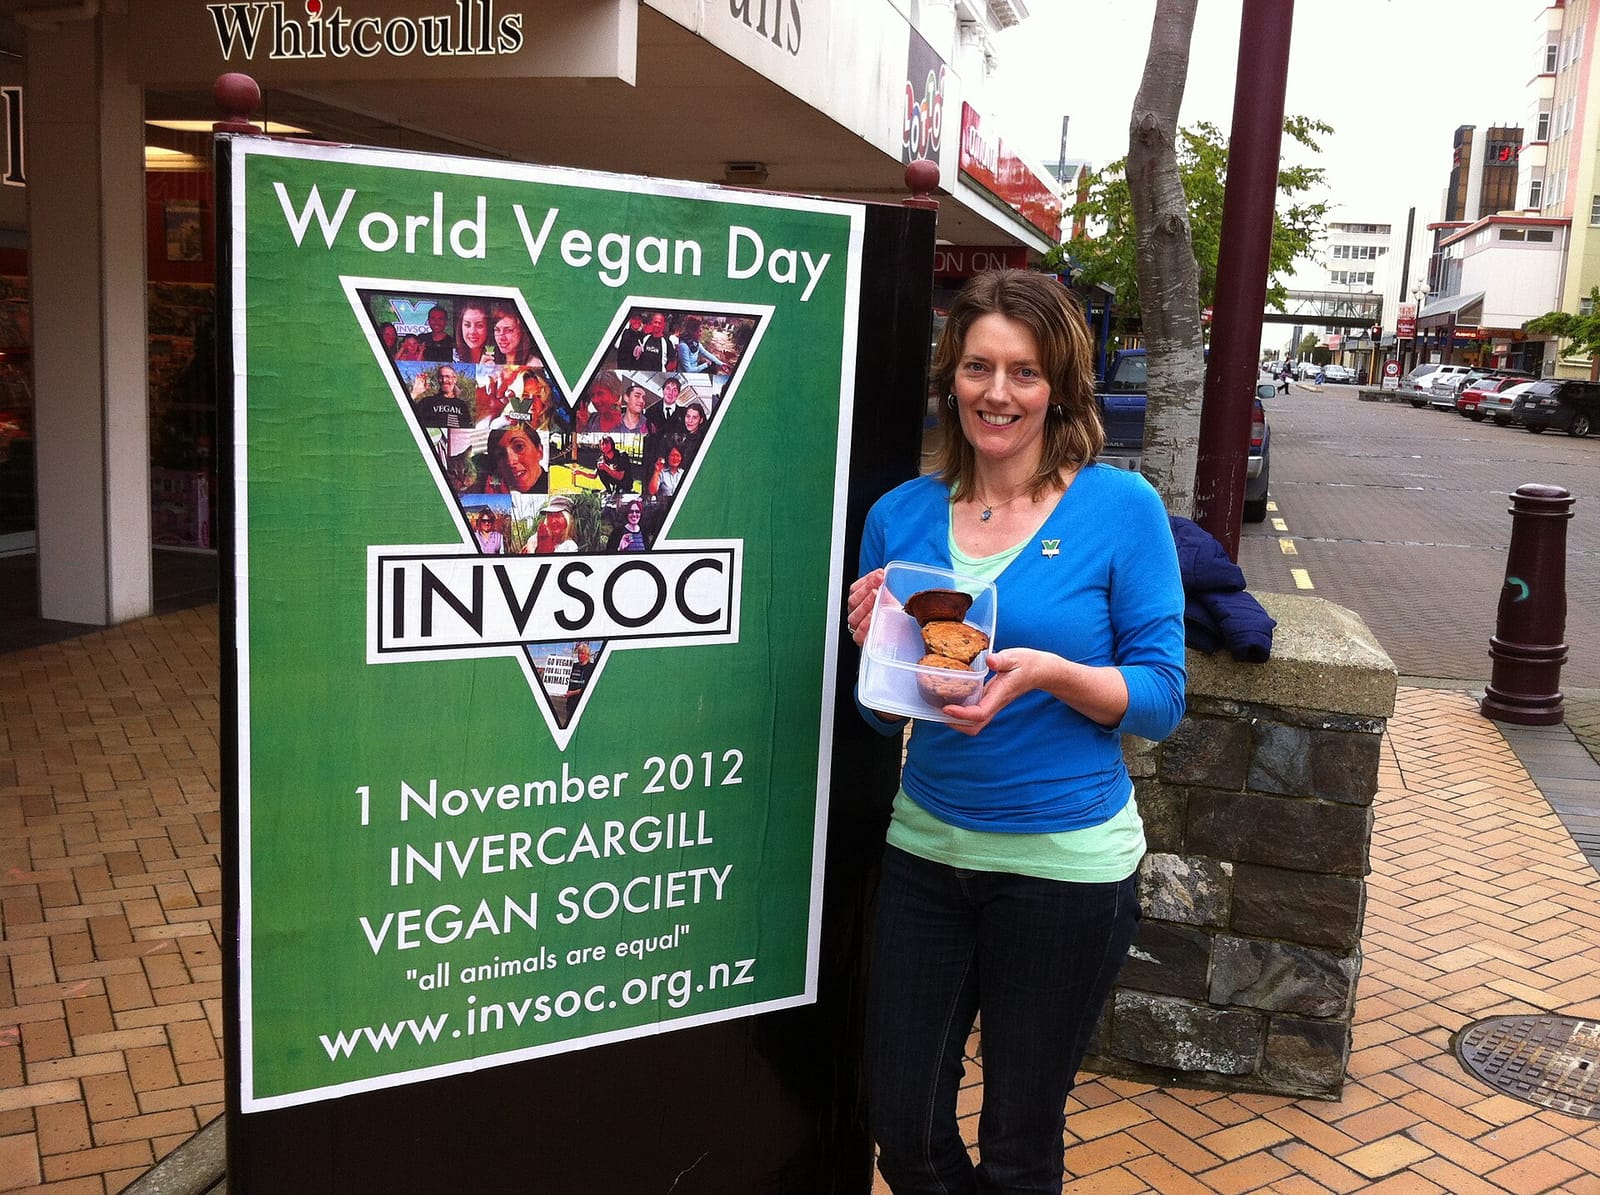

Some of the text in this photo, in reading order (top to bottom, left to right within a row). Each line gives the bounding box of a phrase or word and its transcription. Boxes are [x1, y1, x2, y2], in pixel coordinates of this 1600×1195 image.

[207, 0, 523, 60] Whitcoulls
[273, 181, 832, 302] World Vegan Day
[392, 557, 723, 639] INVSOC
[544, 675, 569, 685] ANIMALS
[556, 659, 572, 667] VEGAN
[355, 748, 744, 826] 1 November 2012
[390, 809, 713, 887] INVERCARGILL
[359, 864, 733, 956] VEGAN SOCIETY
[406, 924, 690, 991] "all animals are equal"
[319, 958, 756, 1063] www.invsoc.org.nz
